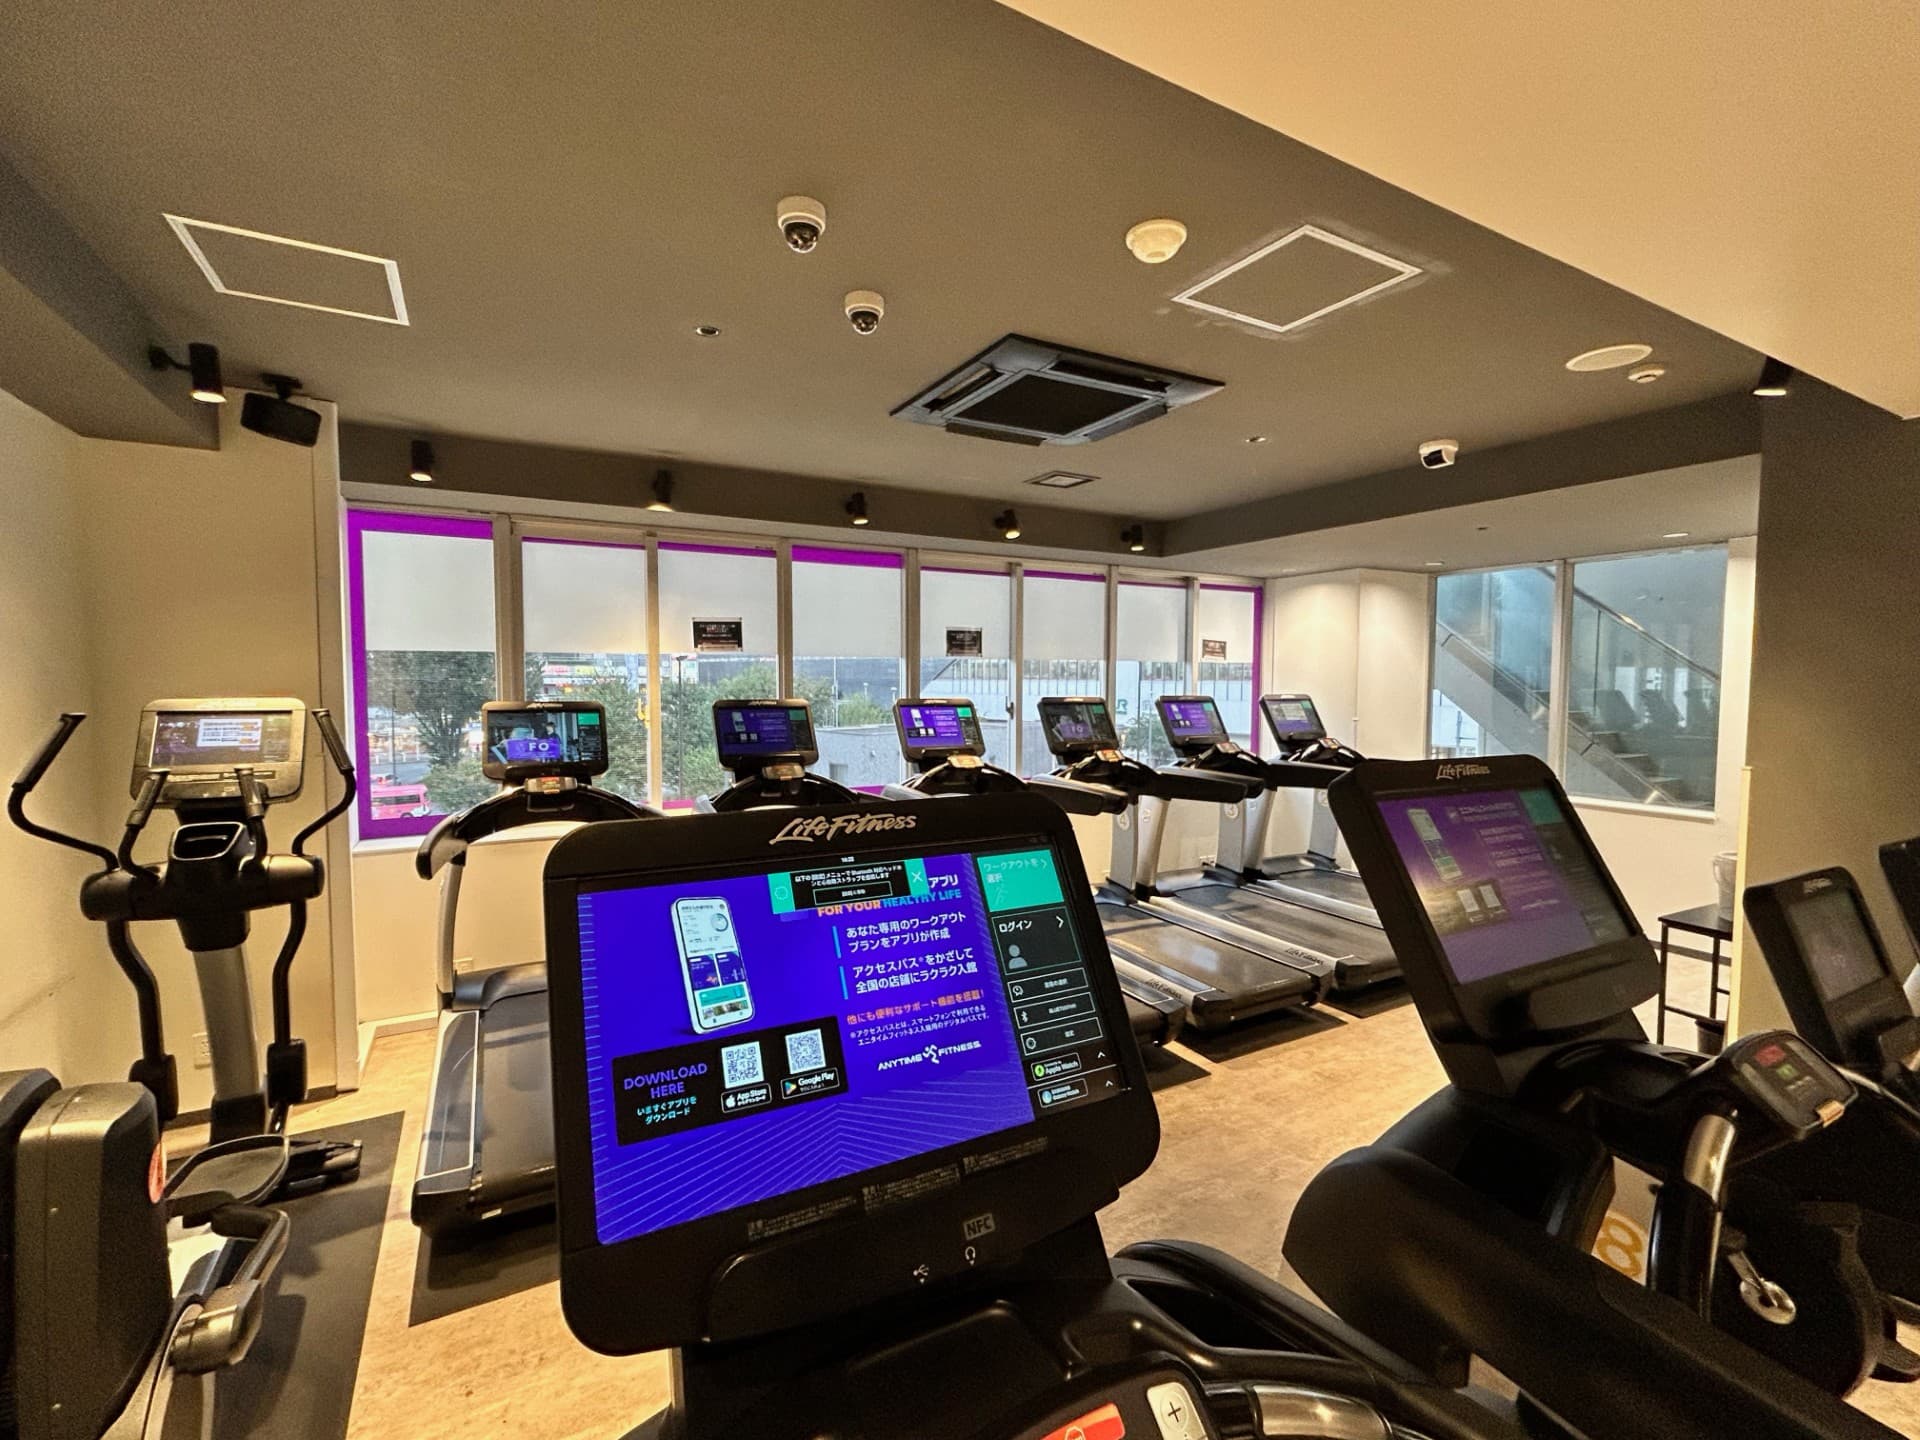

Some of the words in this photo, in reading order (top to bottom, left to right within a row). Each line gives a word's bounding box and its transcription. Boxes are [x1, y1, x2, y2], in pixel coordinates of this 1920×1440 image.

[929, 874, 959, 888] アプリ
[817, 902, 843, 917] FOR
[847, 900, 882, 914] YOUR
[883, 892, 937, 908] HEALTHY
[938, 889, 962, 902] LIFE
[846, 911, 967, 939] あなた専用のワークアウト
[998, 919, 1033, 933] ログイン
[848, 927, 951, 953] プランをアプリが作成
[878, 1053, 922, 1071] ANYTIME
[938, 1040, 982, 1056] FITNESS
[623, 1063, 708, 1090] DOWNLOAD
[798, 1074, 821, 1087] Google
[821, 1071, 835, 1083] Play
[650, 1081, 686, 1099] HERE
[736, 1090, 750, 1101] App
[645, 1107, 691, 1126] ダウンロード
[966, 1217, 992, 1237] NFC
